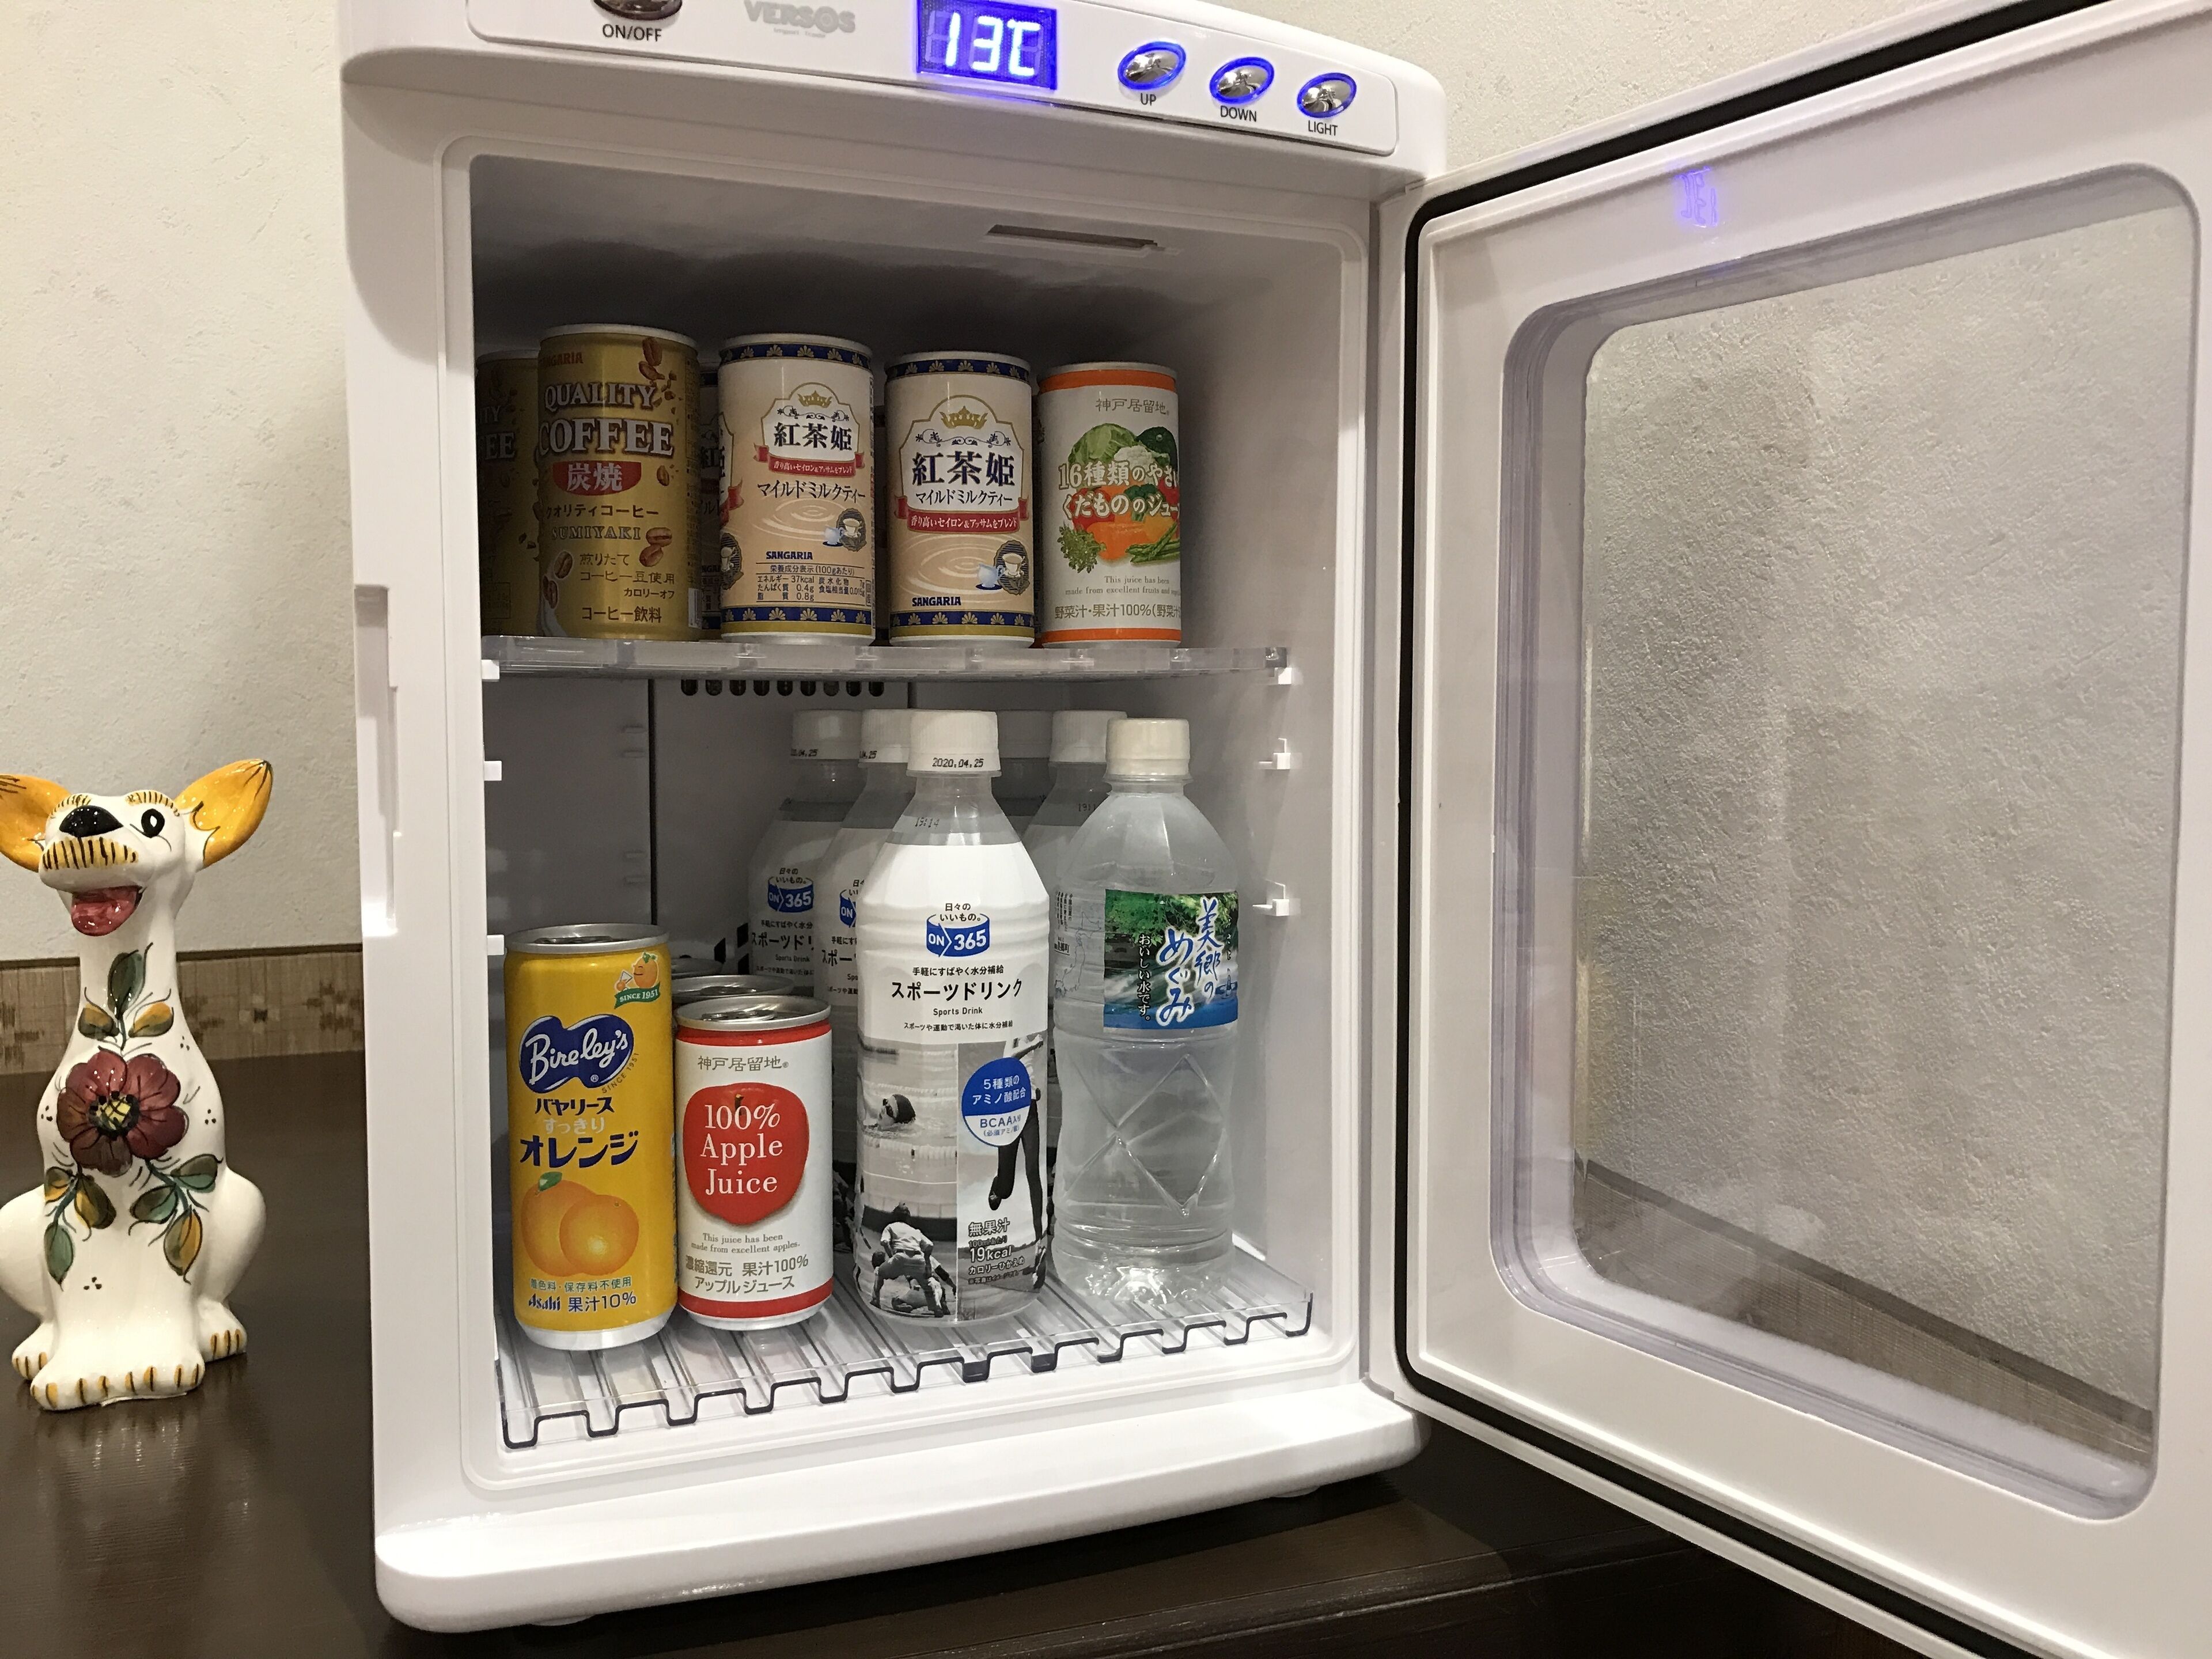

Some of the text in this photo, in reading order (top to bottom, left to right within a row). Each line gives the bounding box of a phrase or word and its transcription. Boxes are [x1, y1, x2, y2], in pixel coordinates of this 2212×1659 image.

[744, 0, 856, 33] VERSOS
[602, 24, 662, 42] ON/OFF
[1140, 93, 1157, 106] UP
[1219, 105, 1257, 122] DOWN
[1307, 120, 1339, 137] LIGHT
[544, 381, 656, 412] QUALITY
[538, 418, 673, 456] COFFEE
[773, 422, 853, 451] 紅茶姫
[567, 462, 623, 491] 炭焼
[912, 450, 1016, 487] 紅茶姫
[757, 479, 866, 503] マイルドミルクティー
[915, 488, 1013, 507] マイルドミルクティー
[546, 503, 659, 519] クオリティコーヒー
[1063, 491, 1180, 520] くだもののジュー
[551, 525, 641, 540] SUMIYAKI
[579, 553, 631, 566] 煎りたて
[766, 551, 813, 560] SANGARIA
[579, 570, 675, 585] コーヒー豆使用
[757, 575, 789, 583] エネルギー
[791, 575, 815, 584] 37kcal
[1104, 575, 1121, 584] This
[1124, 576, 1142, 585] juice
[623, 587, 675, 600] カロリーオフ
[757, 583, 789, 592] たんぱく質
[796, 584, 815, 593] 0.4g
[796, 592, 815, 602] 0.8g
[1142, 586, 1160, 594] fruits
[912, 596, 961, 607] SANGARIA
[582, 606, 662, 623] コーヒー飲料
[932, 757, 984, 768] 2020.04.25
[768, 891, 812, 908] ON 365
[945, 903, 971, 912] 日々の
[840, 906, 853, 919] ON
[940, 913, 981, 922] いいもの。
[928, 929, 987, 951] ON 365
[1194, 896, 1224, 999] 美郷の
[821, 949, 857, 967] スポー
[912, 964, 1004, 976] 手軽にすばやく水分補給
[1138, 934, 1152, 1021] おいしい水です。
[1158, 927, 1195, 1024] めぐみ
[619, 988, 658, 1003] SINCE 1951
[891, 978, 1022, 1001] スポーツドリンク
[933, 1006, 983, 1017] Sports Drink
[904, 1020, 1013, 1032] スポーツや運動で渇いた体に水分補給
[525, 1027, 628, 1085] Bireley's
[601, 1052, 639, 1093] SINCE 1951
[983, 1075, 1020, 1090] 5種類の
[972, 1086, 1027, 1105] アミノ酸配合
[535, 1096, 615, 1116] バヤリース
[543, 1116, 605, 1134] すっきり
[704, 1103, 781, 1130] 100%
[520, 1130, 639, 1168] オレンジ
[700, 1132, 783, 1166] Apple
[705, 1168, 778, 1195] Juice
[968, 1217, 1010, 1237] 無果汁
[691, 1241, 801, 1253] made from excellent apples.
[703, 1233, 783, 1244] This juice has been
[970, 1245, 1013, 1263] 19kcal
[685, 1254, 809, 1277] 濃縮還元 果汁100%
[968, 1256, 1025, 1275] カロリーひかえめ
[531, 1276, 631, 1293] 着色料・保存料不使用
[694, 1275, 795, 1294] アップルジュース
[528, 1290, 637, 1312] Asahi 果汁10%
